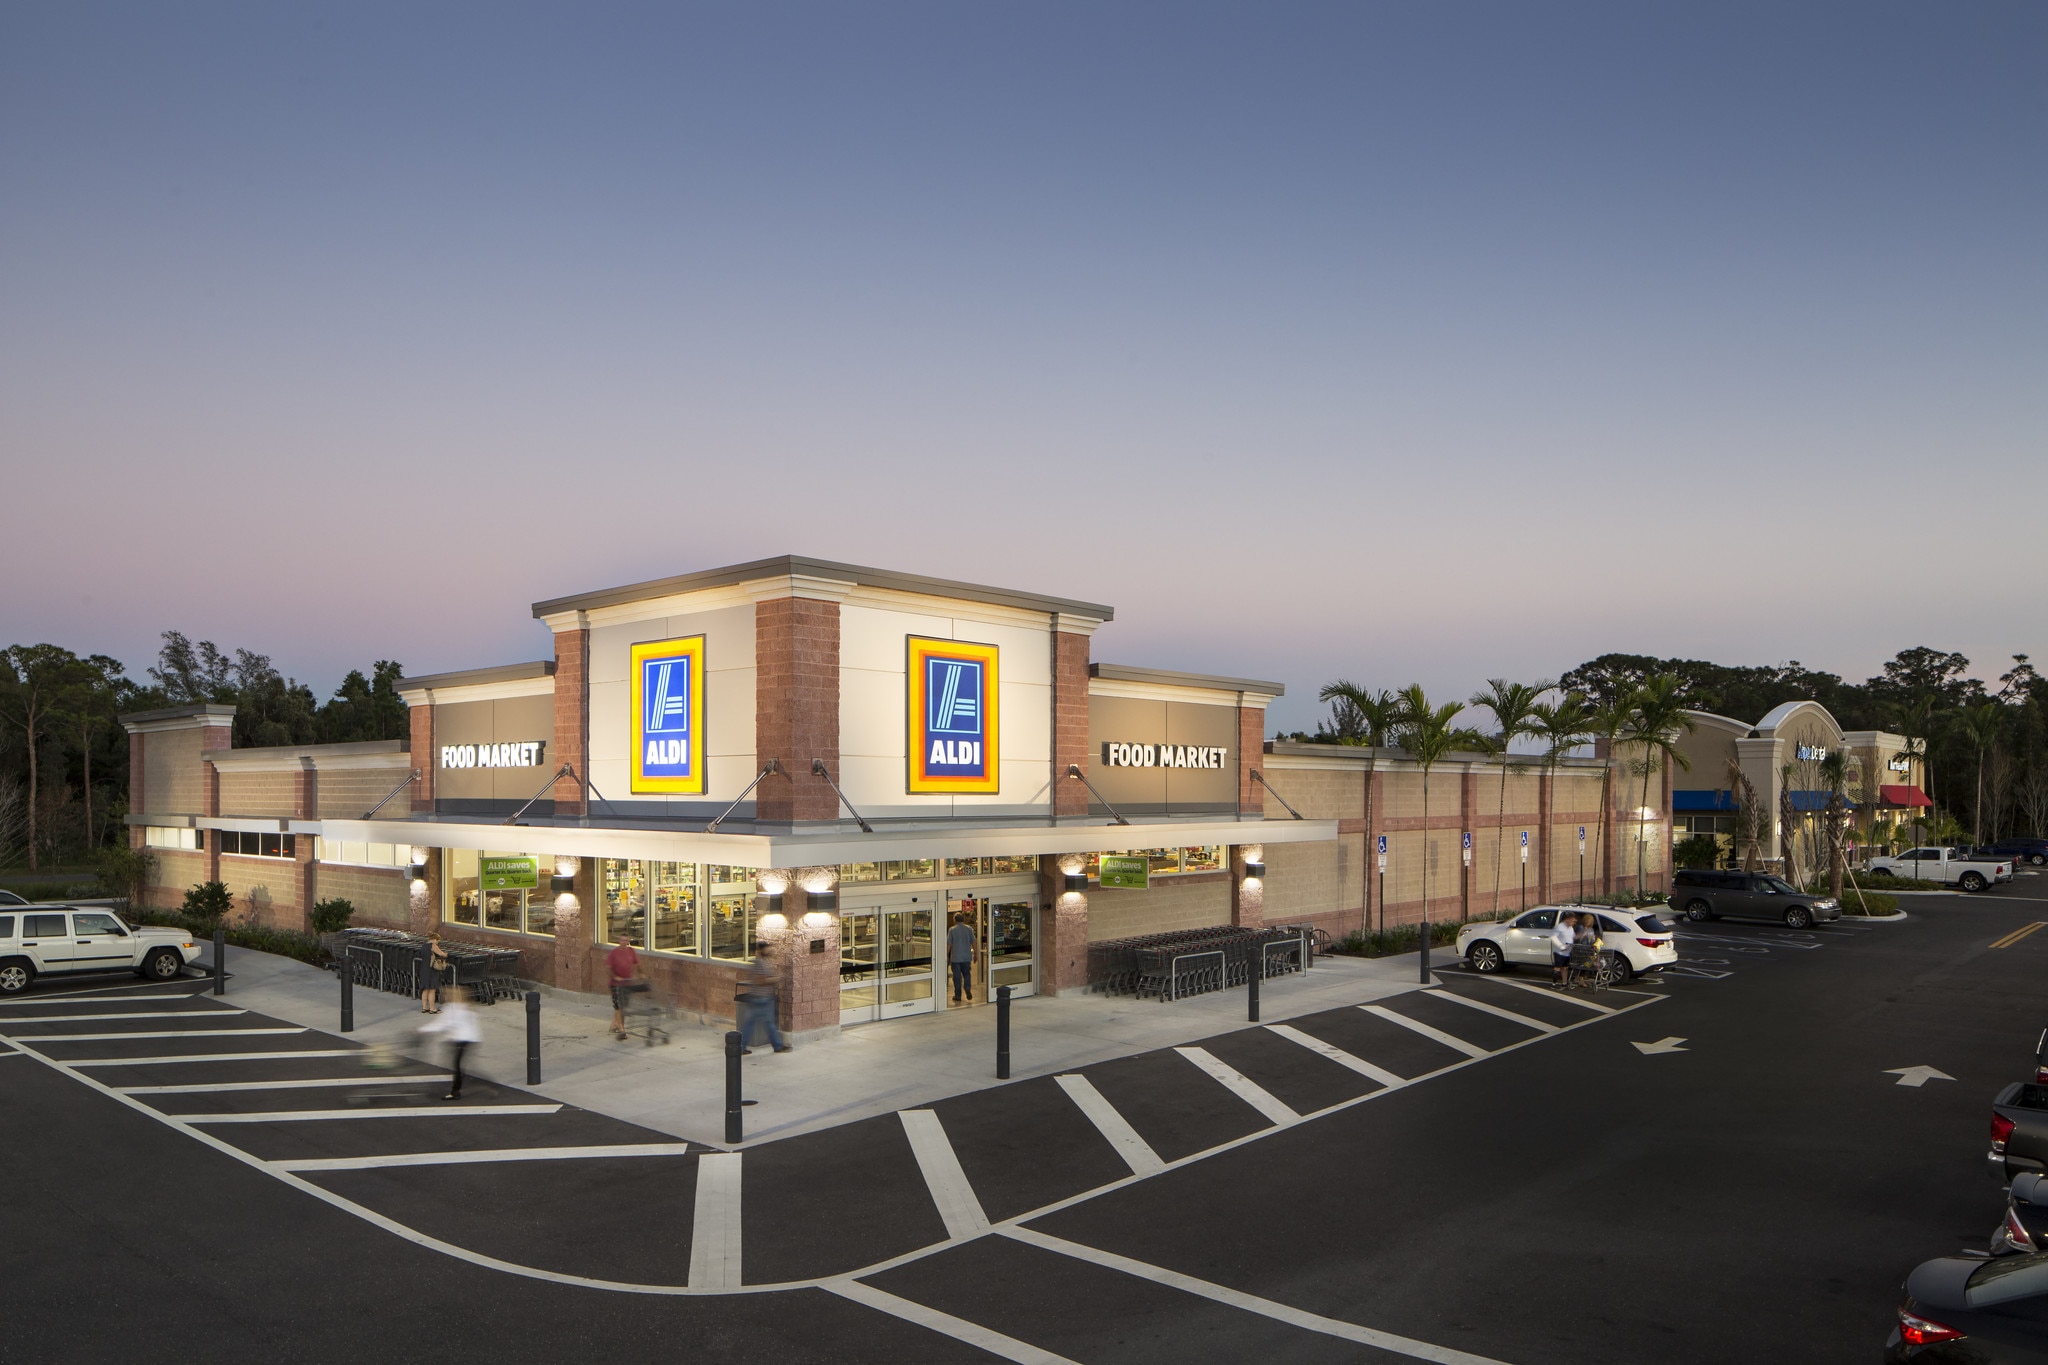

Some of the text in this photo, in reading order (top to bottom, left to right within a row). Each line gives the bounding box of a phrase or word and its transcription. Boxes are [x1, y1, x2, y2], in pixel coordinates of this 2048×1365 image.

[441, 742, 539, 769] FOOD MARKET
[645, 739, 687, 765] ALDI
[929, 739, 981, 765] ALDI
[1109, 743, 1228, 769] FOOD MARKET
[487, 861, 506, 870] ALDI
[1106, 860, 1141, 869] ALDI saves
